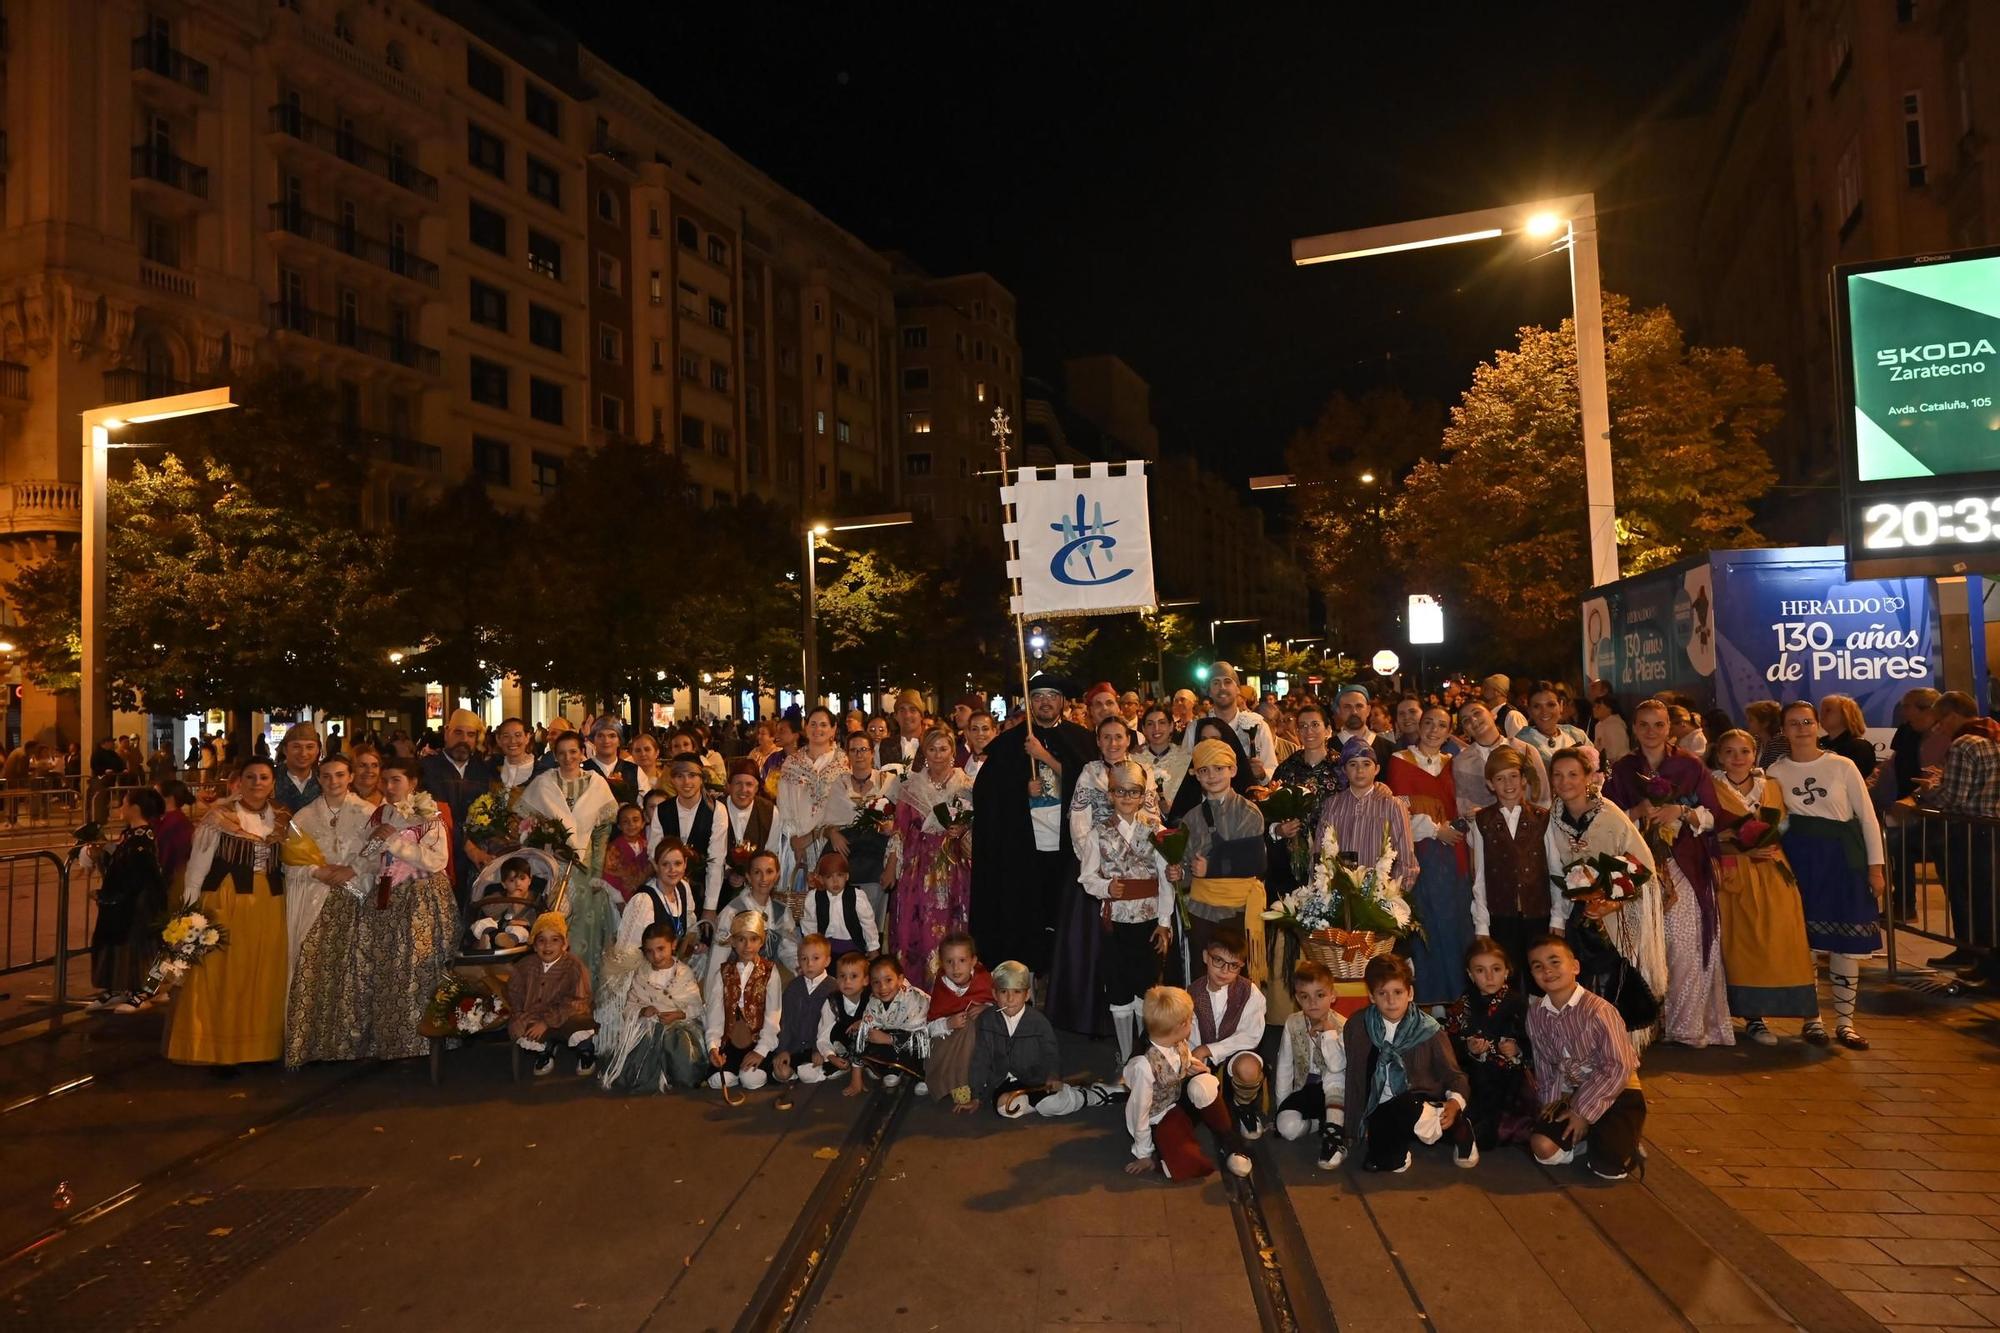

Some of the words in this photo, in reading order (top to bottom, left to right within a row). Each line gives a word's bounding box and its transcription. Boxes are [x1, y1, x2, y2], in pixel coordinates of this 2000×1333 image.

[1889, 361, 1985, 382] Zaratecno
[1888, 405, 1918, 416] Avda.
[1919, 400, 1970, 413] Cataluña,
[1971, 397, 1992, 408] 105
[1865, 497, 2000, 549] 20:3
[1780, 598, 1880, 616] HERALDO
[1772, 621, 1834, 652] 130
[1846, 623, 1919, 650] años
[1766, 652, 1803, 683] de
[1812, 650, 1928, 680] Pilares
